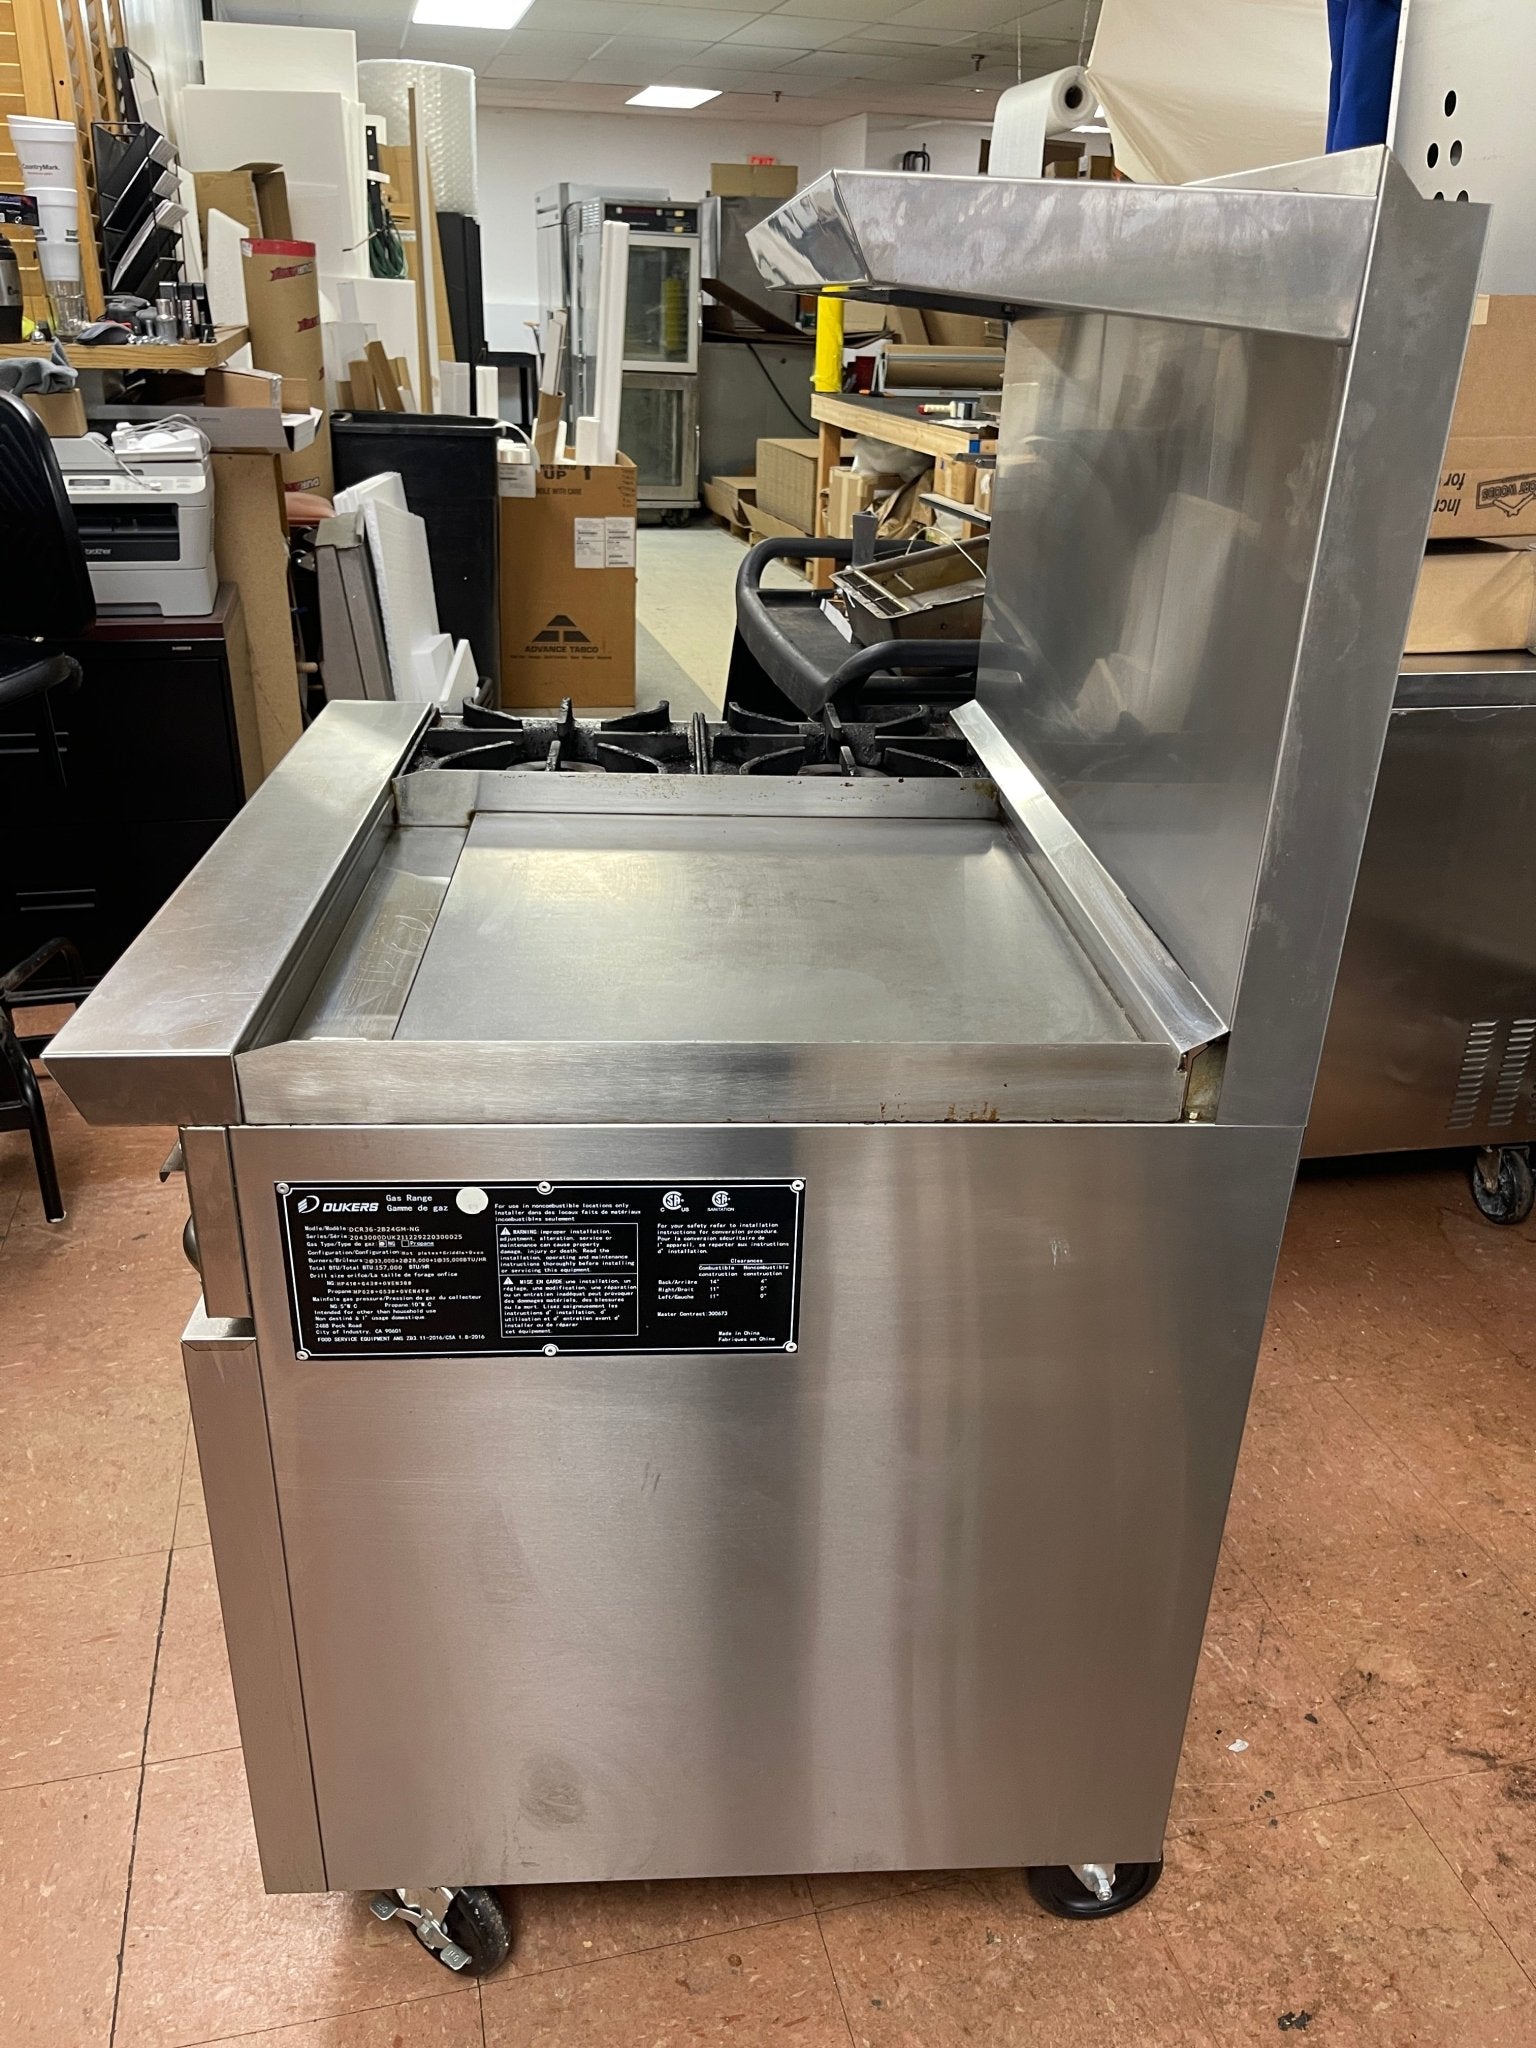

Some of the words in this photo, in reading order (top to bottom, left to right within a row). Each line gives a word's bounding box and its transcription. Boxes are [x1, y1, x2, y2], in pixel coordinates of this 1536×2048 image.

[544, 470, 567, 479] UP
[1443, 473, 1466, 490] for
[1482, 483, 1517, 501] WOODS
[406, 1194, 433, 1202] Range
[322, 1203, 379, 1212] DUKERS
[387, 1204, 412, 1212] Gamme
